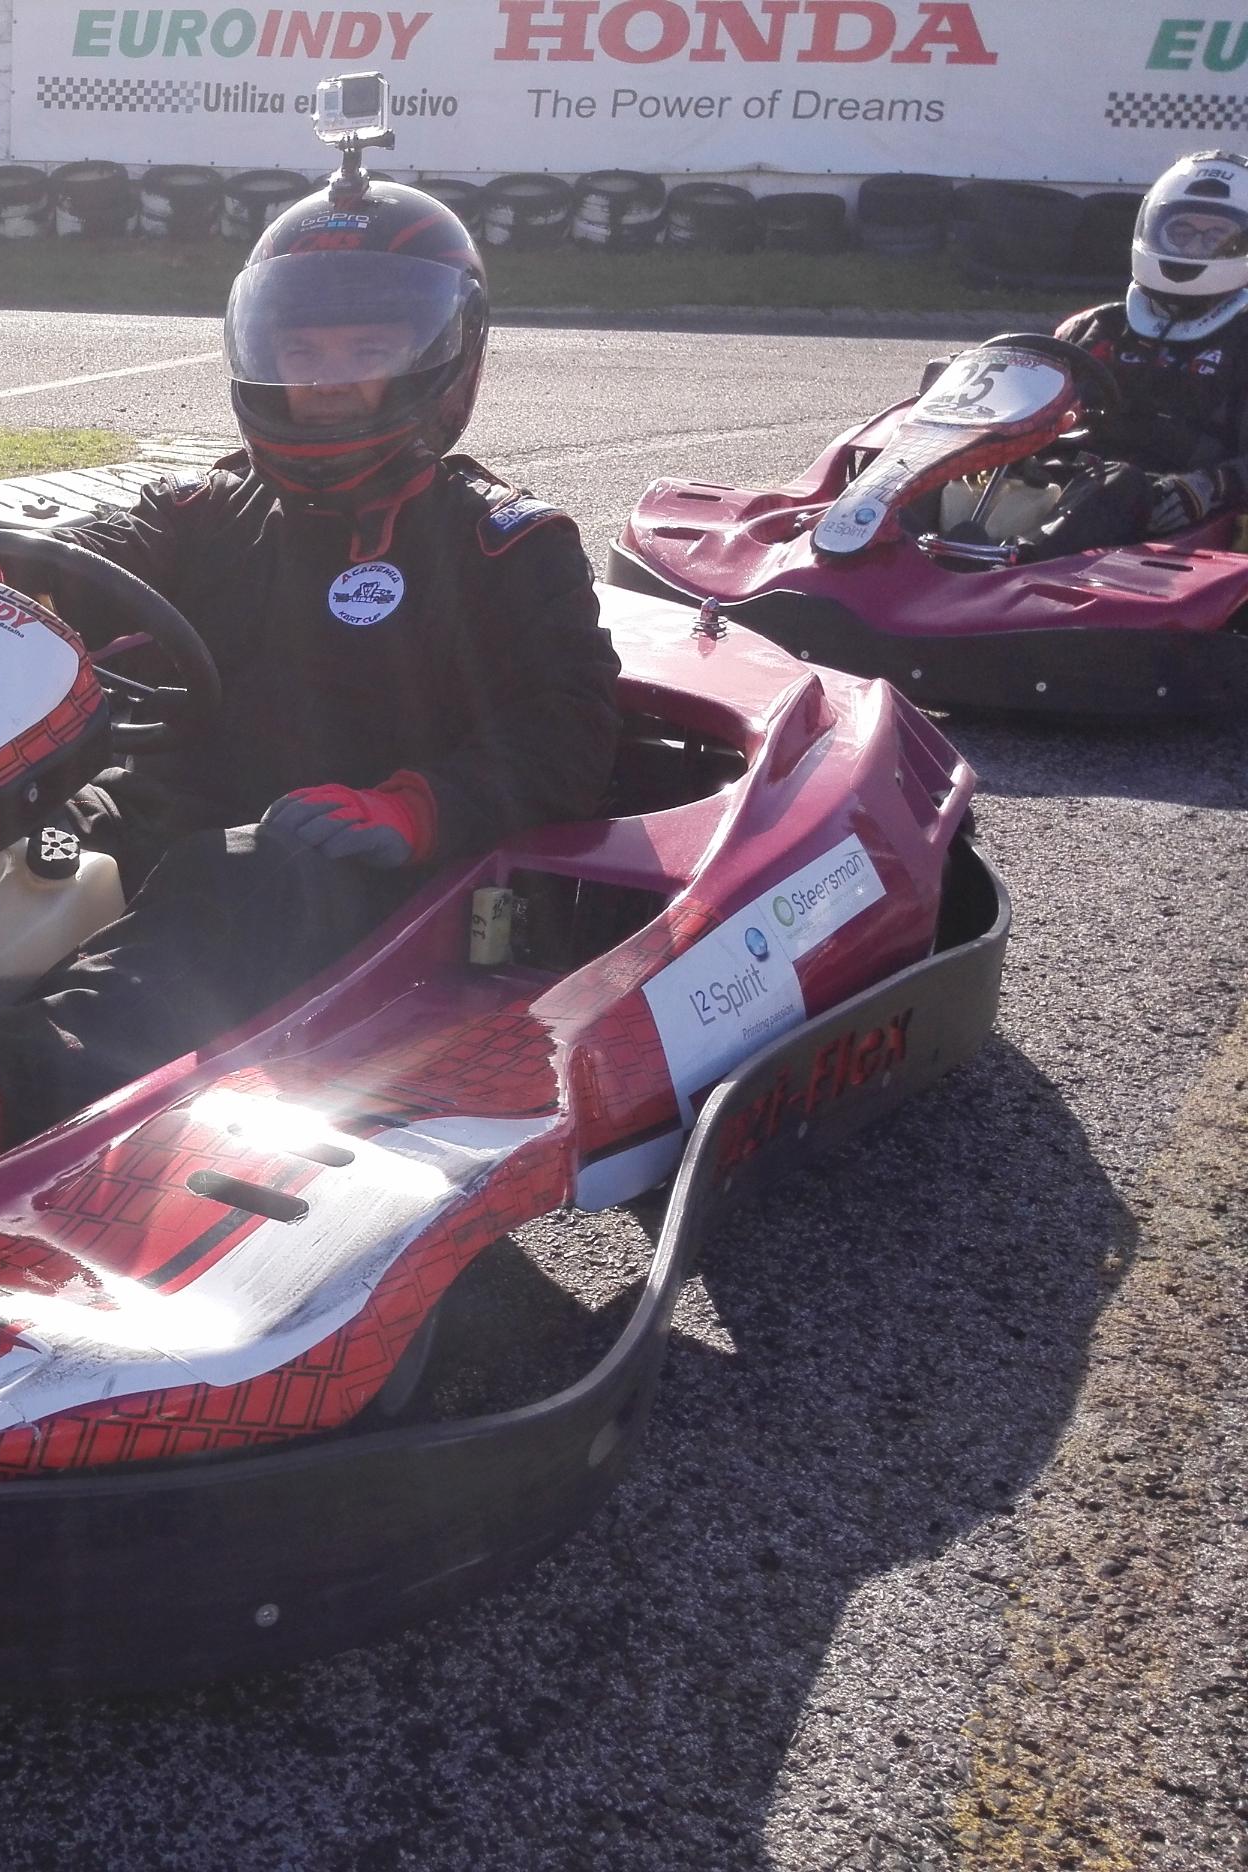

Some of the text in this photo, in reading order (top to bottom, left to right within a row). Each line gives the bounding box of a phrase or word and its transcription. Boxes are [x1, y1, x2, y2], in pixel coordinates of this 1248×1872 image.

[72, 8, 433, 60] EUROINDY
[493, 0, 998, 65] HONDA
[204, 82, 285, 114] Utiliza
[528, 89, 945, 123] The Power of Dreams
[338, 610, 381, 623] KART CUP
[791, 853, 865, 916] Steersman
